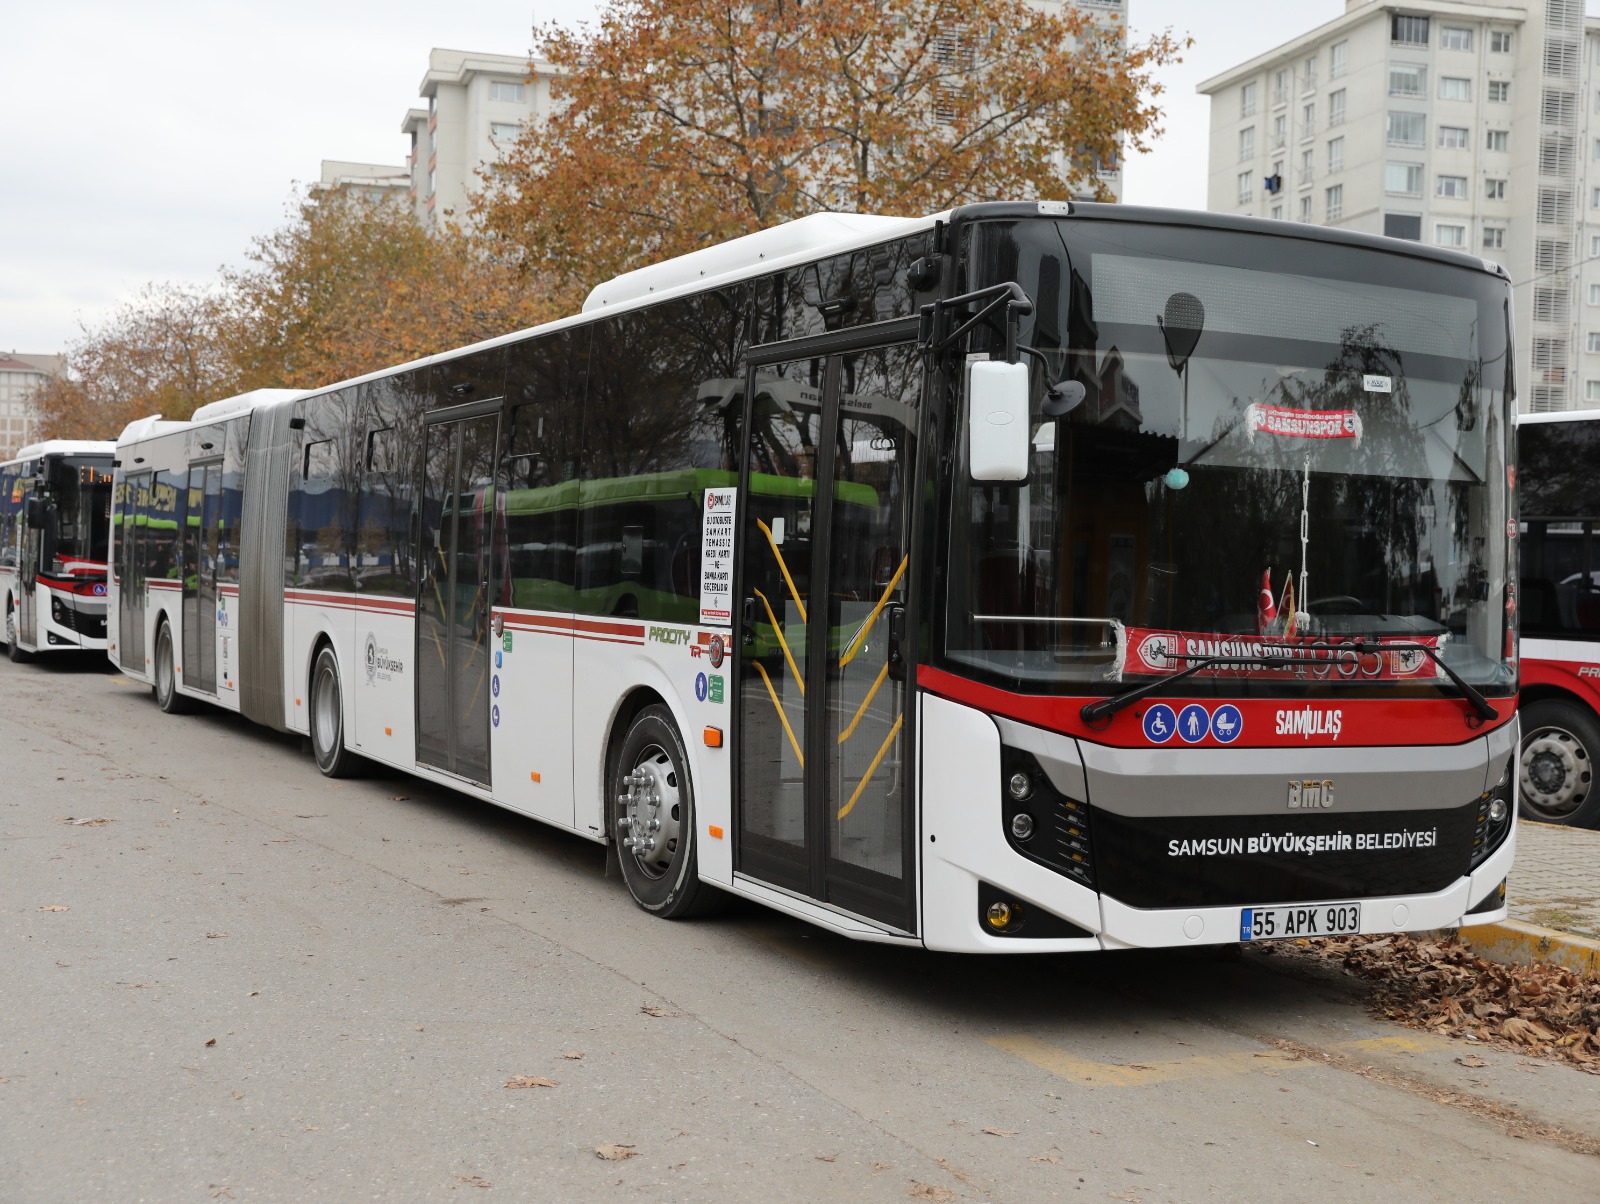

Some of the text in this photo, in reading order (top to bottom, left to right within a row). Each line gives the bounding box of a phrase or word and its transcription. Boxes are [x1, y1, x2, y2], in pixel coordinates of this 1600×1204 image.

[1267, 415, 1342, 436] SAMSUNSPOR
[706, 538, 731, 547] TEMASSIZ
[649, 626, 691, 645] PROCITY
[689, 645, 701, 658] TR
[1577, 666, 1600, 679] PR
[1287, 779, 1334, 809] BMC
[1168, 827, 1437, 856] SAMSUN BÜYÜKŞEHİR BELEDİYESİ
[1242, 906, 1358, 936] TR 55 APK 903
